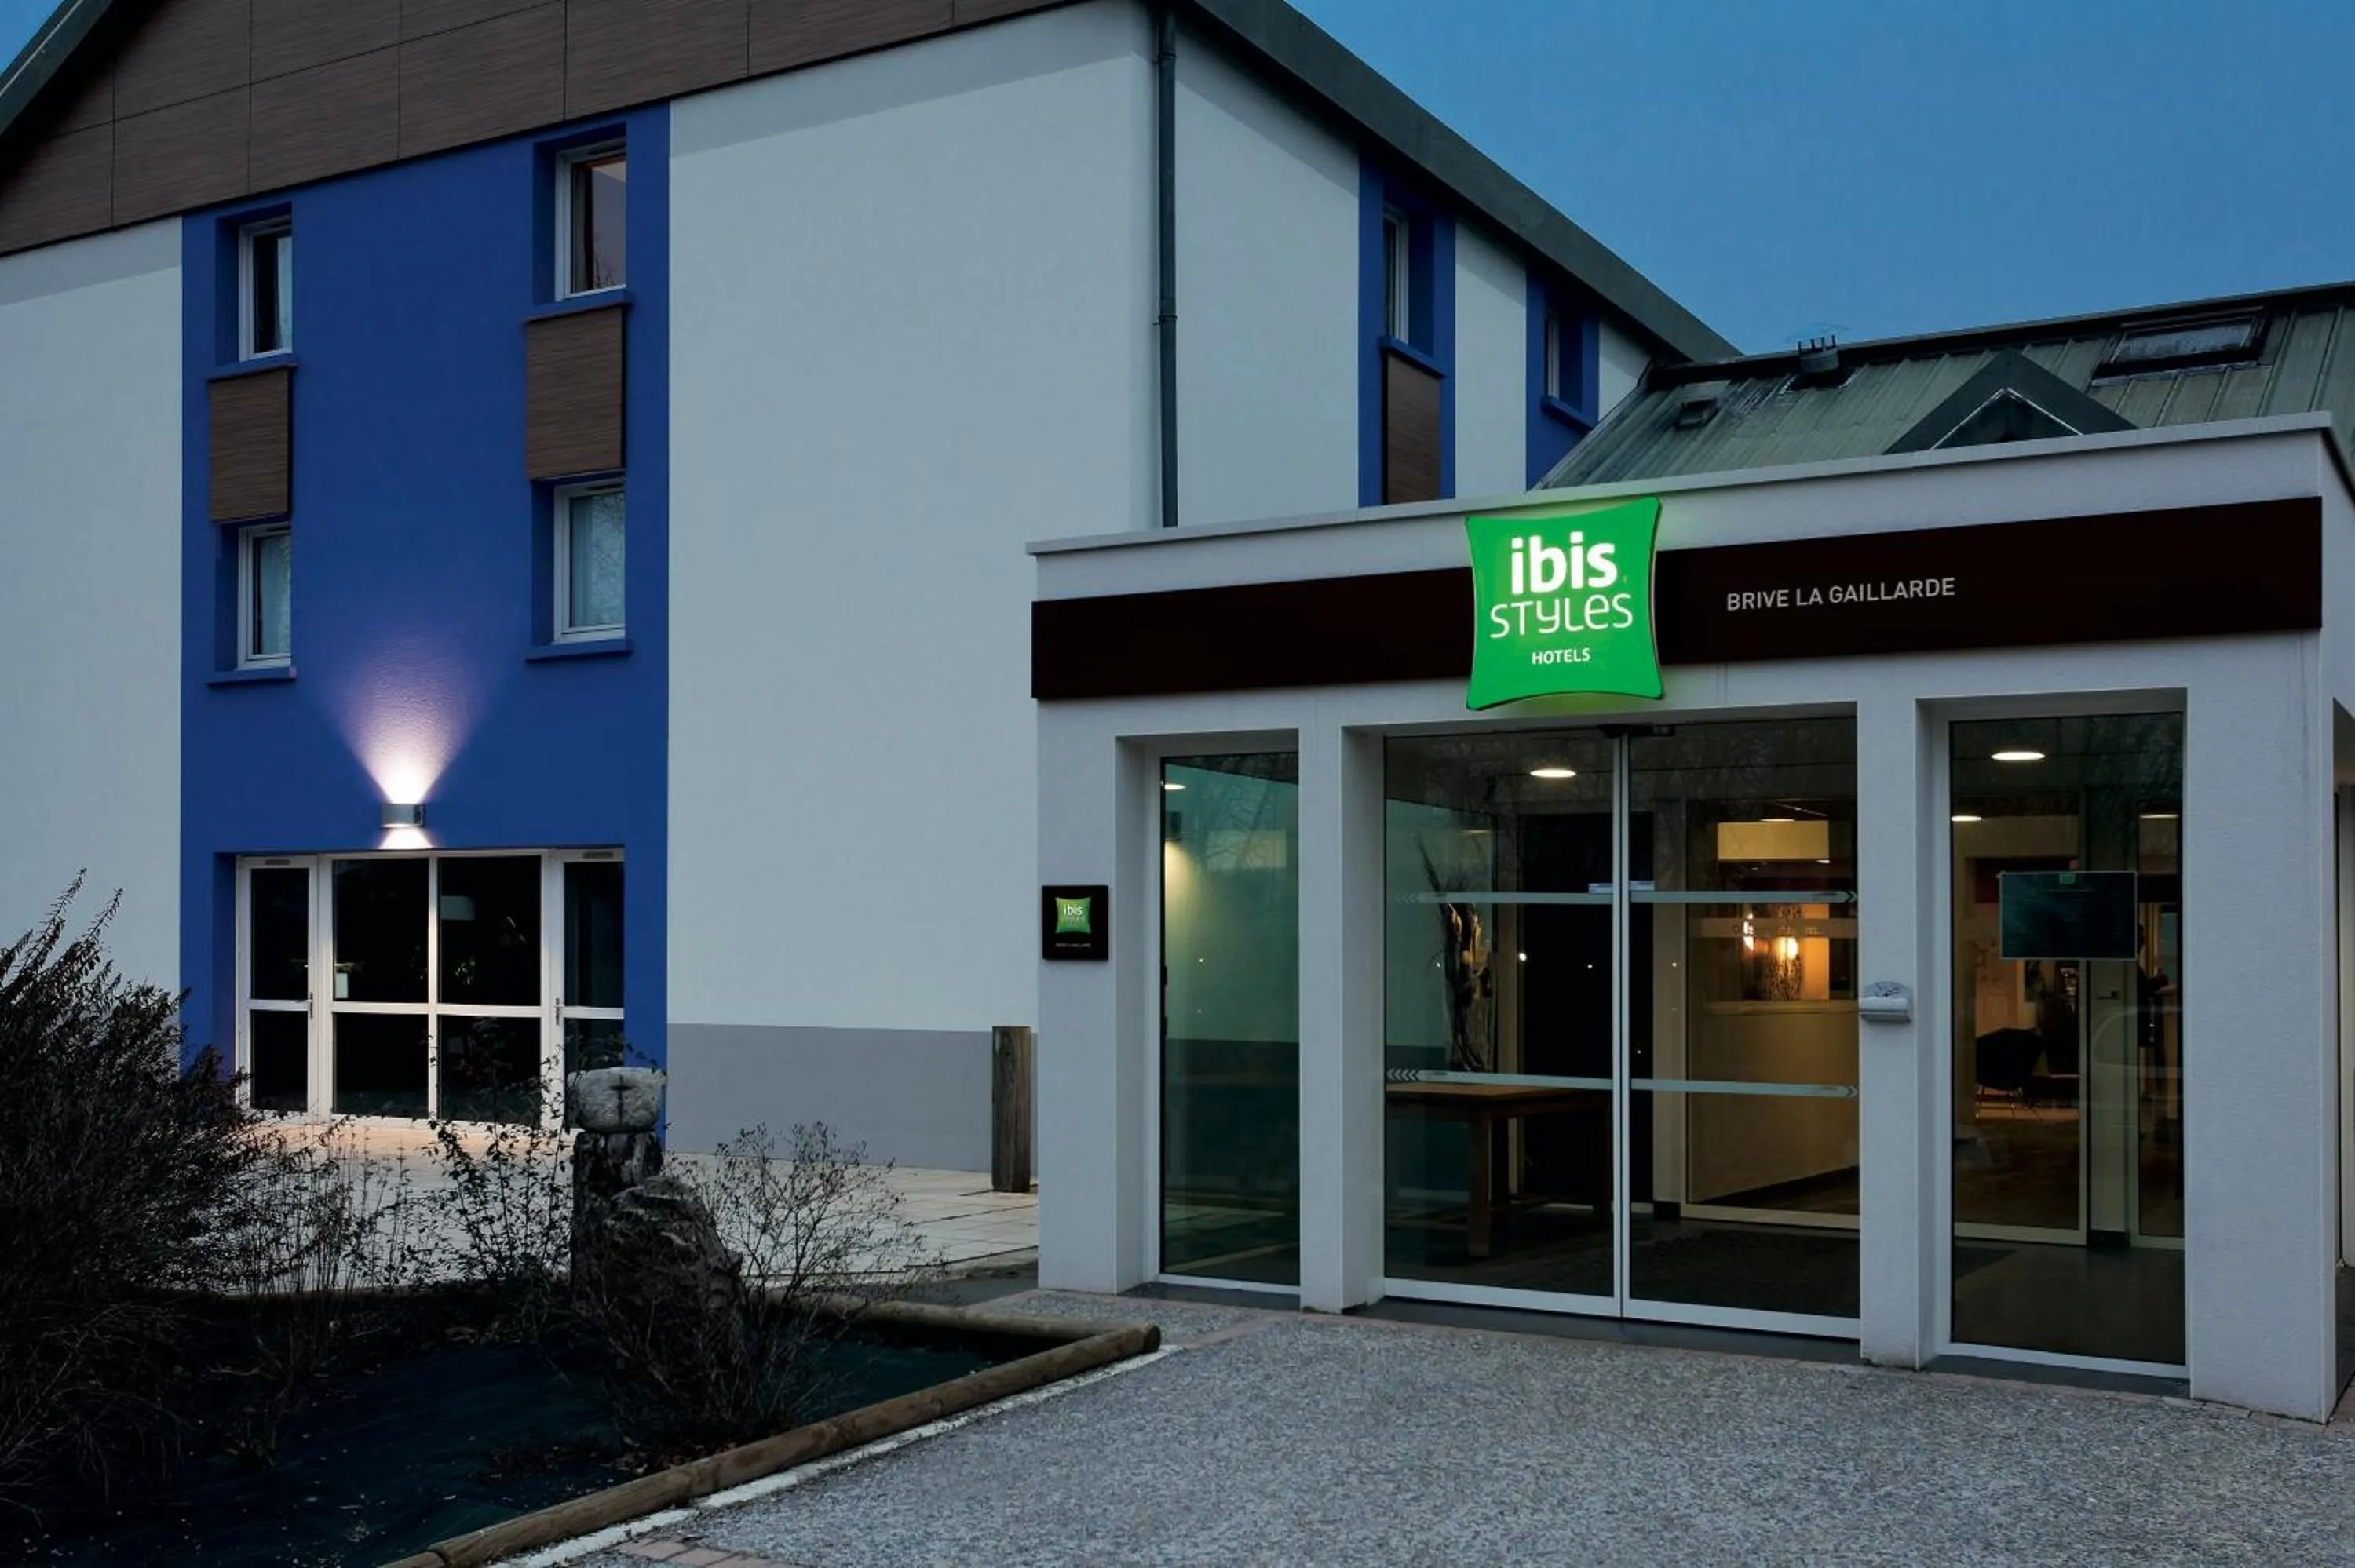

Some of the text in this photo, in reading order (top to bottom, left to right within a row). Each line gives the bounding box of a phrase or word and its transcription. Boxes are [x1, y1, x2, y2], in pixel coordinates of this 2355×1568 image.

[1511, 531, 1618, 595] ibis
[1727, 577, 1955, 611] BRIVE LA GAILLARDE
[1532, 647, 1590, 665] HOTELS
